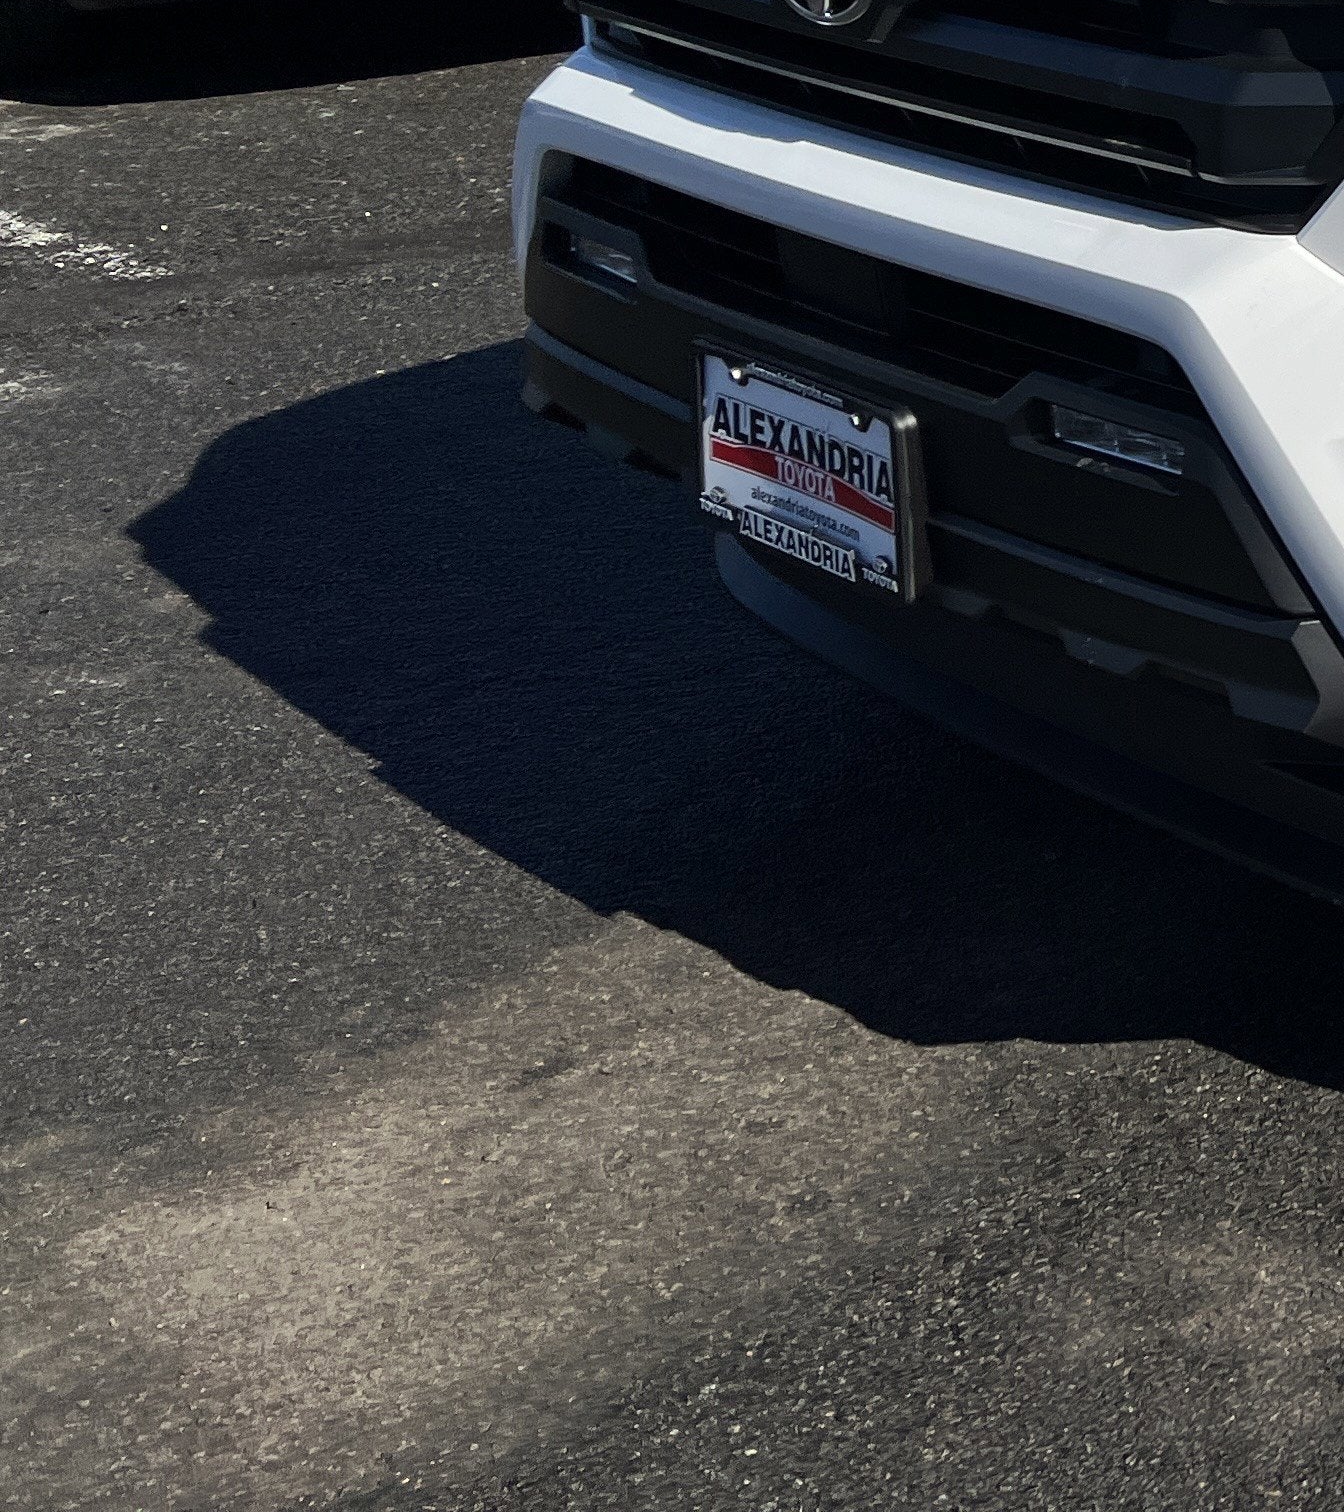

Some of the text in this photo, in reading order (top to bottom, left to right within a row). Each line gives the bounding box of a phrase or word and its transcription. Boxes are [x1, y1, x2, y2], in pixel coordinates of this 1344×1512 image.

[712, 396, 894, 504] ALEXANDRIA
[775, 454, 837, 504] TOYOTA
[700, 497, 734, 521] TOYOTA
[740, 507, 856, 582] ALEXANDRIA
[862, 567, 898, 593] TOYOTA
